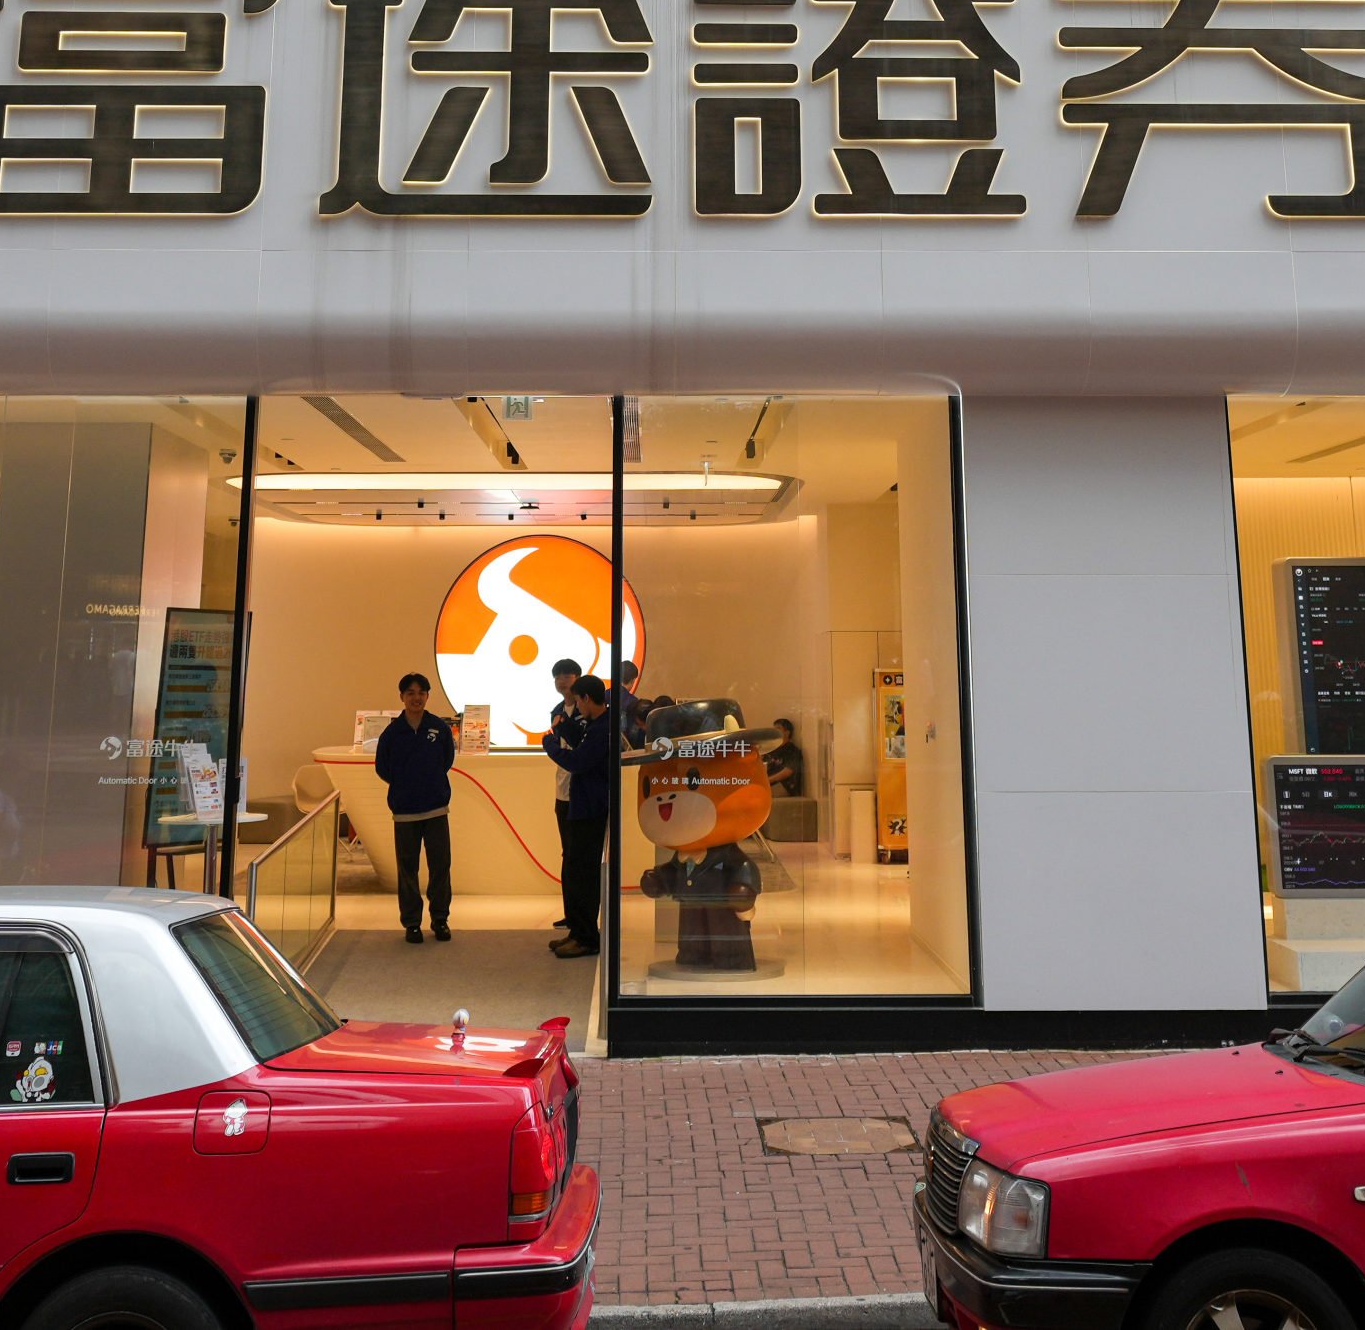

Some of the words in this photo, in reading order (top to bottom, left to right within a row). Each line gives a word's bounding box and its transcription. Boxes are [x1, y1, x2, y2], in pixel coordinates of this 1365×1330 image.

[677, 740, 752, 758] 富途牛牛
[98, 776, 137, 785] Automatic
[138, 776, 158, 785] Door
[691, 777, 730, 785] Automatic
[732, 777, 751, 785] Door
